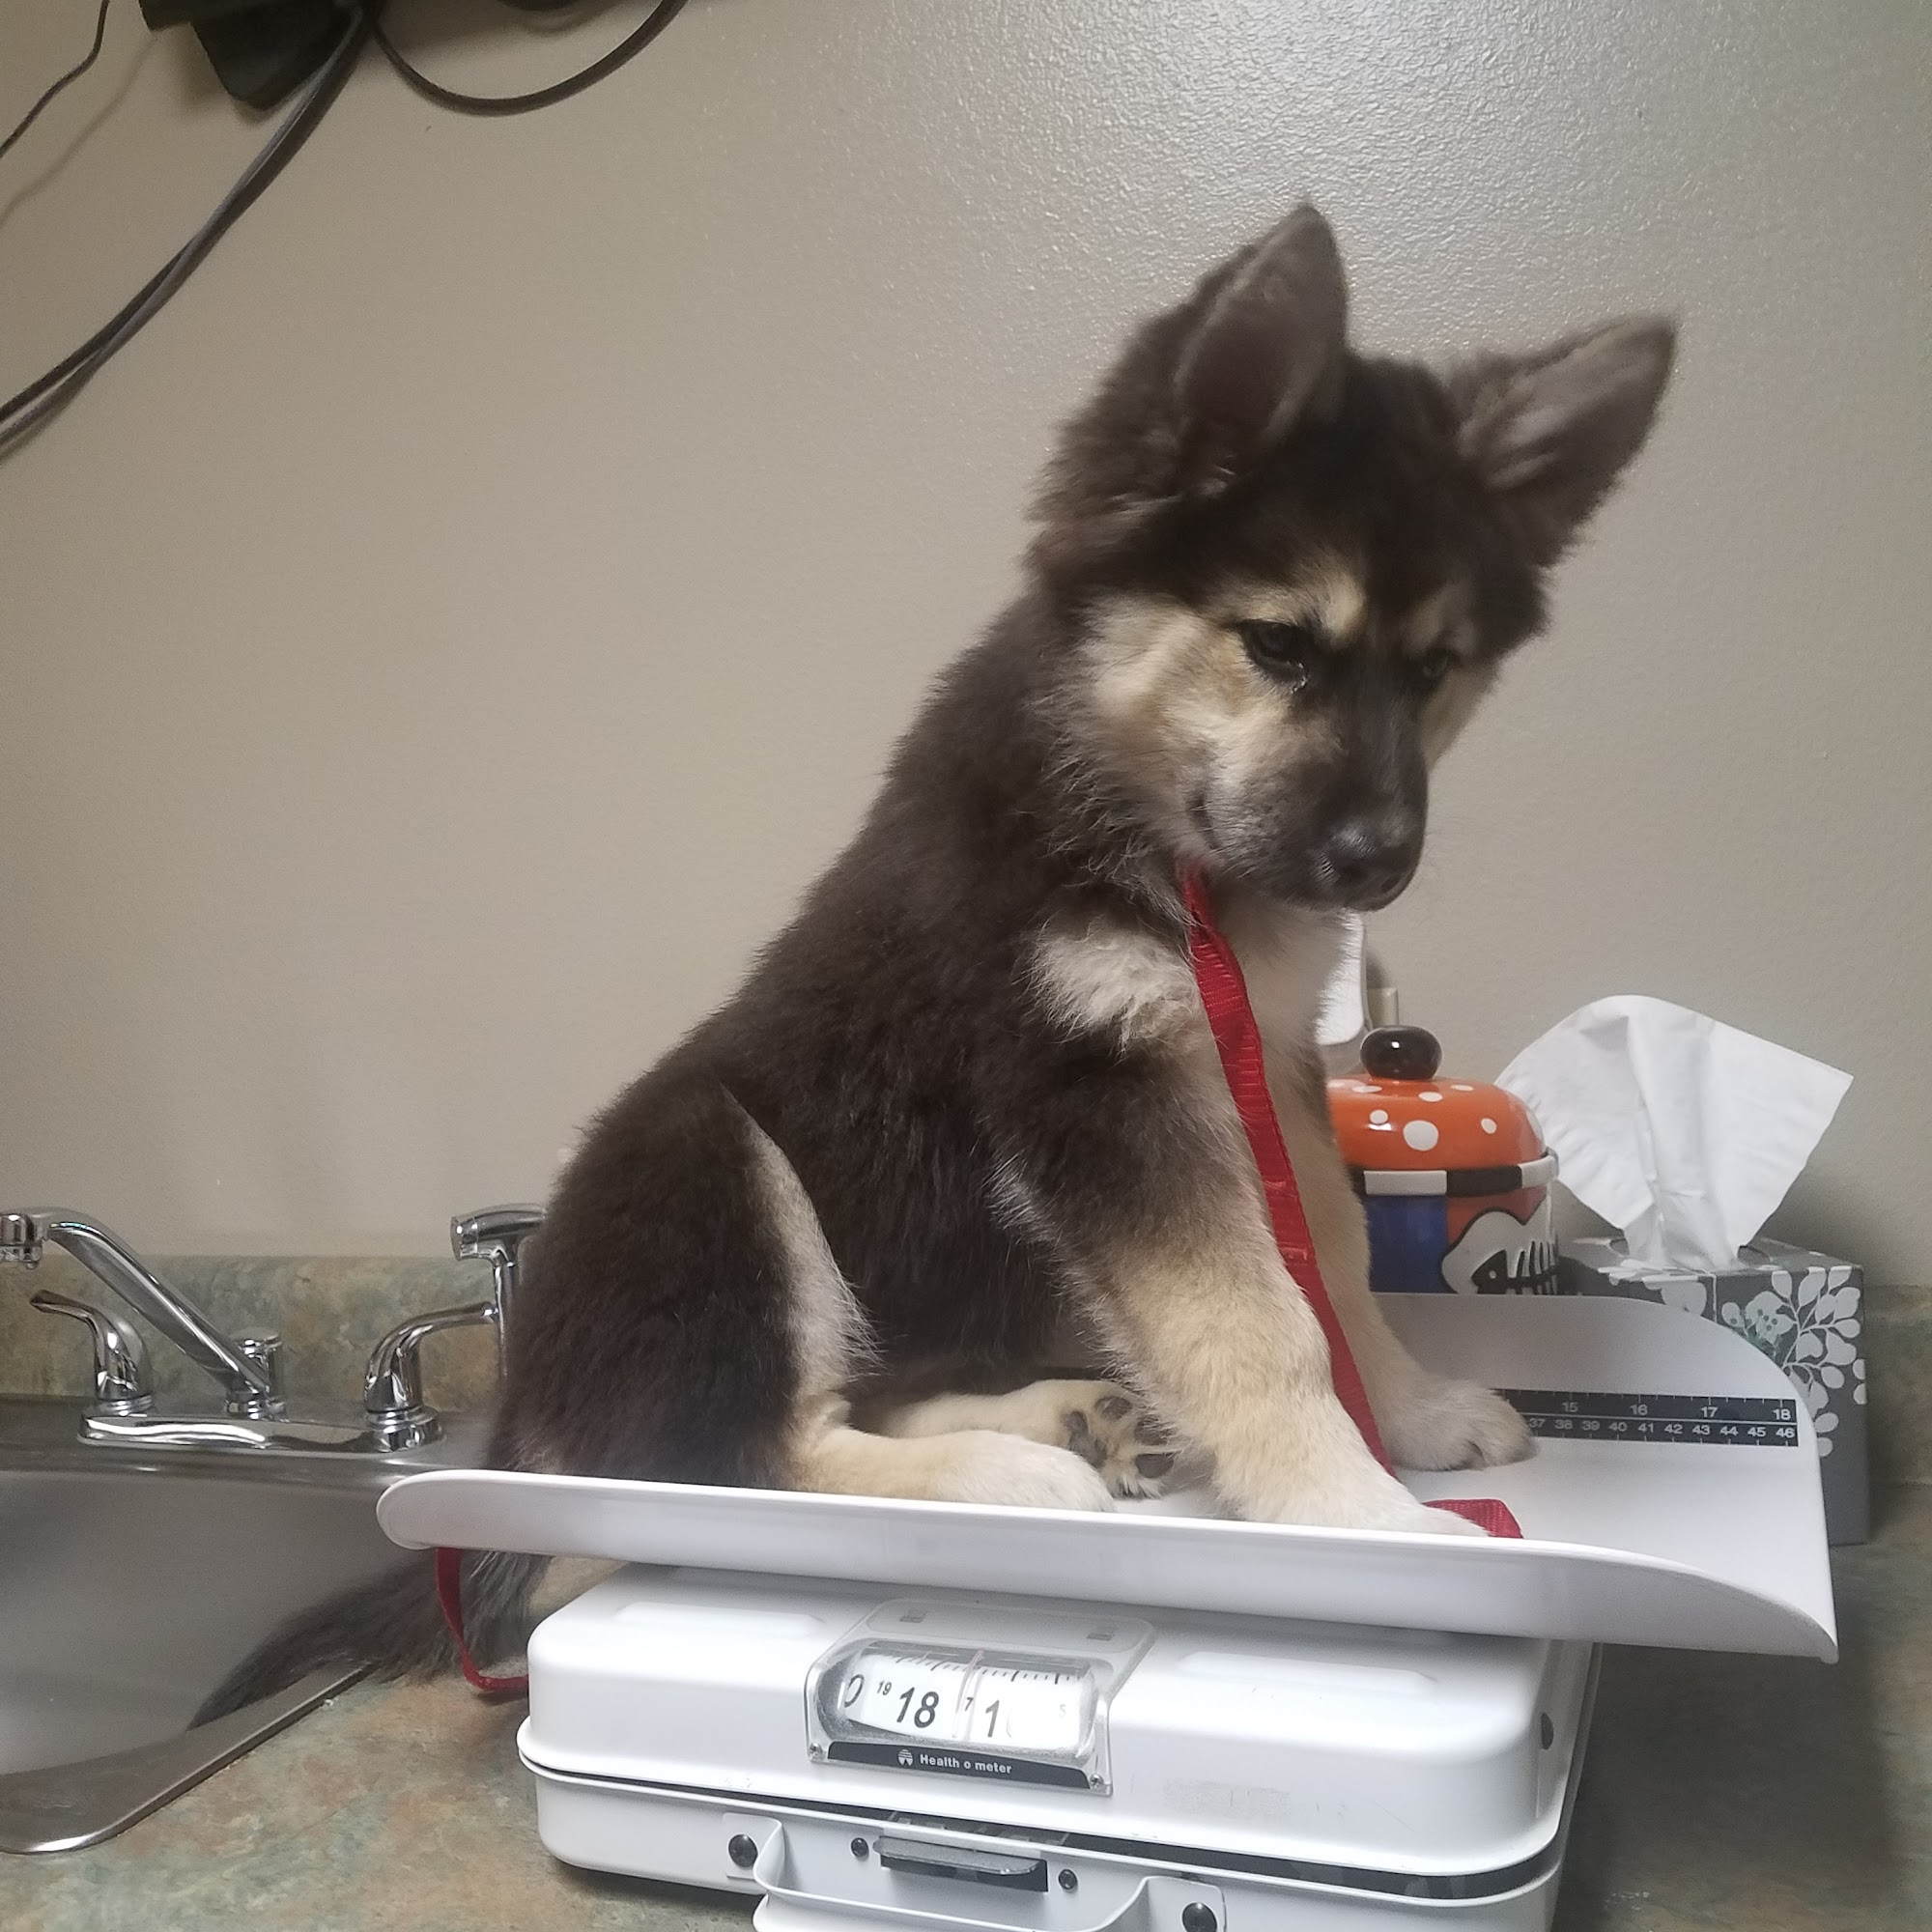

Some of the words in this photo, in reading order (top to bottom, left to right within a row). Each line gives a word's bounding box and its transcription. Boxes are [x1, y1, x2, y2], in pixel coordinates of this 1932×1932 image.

[1562, 1401, 1578, 1412] 15
[1630, 1405, 1648, 1416] 16
[1701, 1406, 1719, 1418] 17
[1773, 1408, 1791, 1420] 18
[1528, 1417, 1546, 1428] 37
[1554, 1418, 1573, 1430] 38
[1581, 1420, 1600, 1431] 39
[1608, 1421, 1628, 1432] 40
[1637, 1422, 1654, 1434] 41
[1664, 1423, 1684, 1435] 42
[1691, 1424, 1711, 1435] 43
[1720, 1425, 1739, 1436] 44
[1747, 1426, 1767, 1437] 45
[1776, 1427, 1795, 1438] 46
[876, 1680, 892, 1696] 19
[896, 1687, 940, 1728] 18
[985, 1700, 1012, 1738] 1
[920, 1753, 959, 1770] Health
[963, 1760, 972, 1770] o
[975, 1761, 1012, 1775] meter
